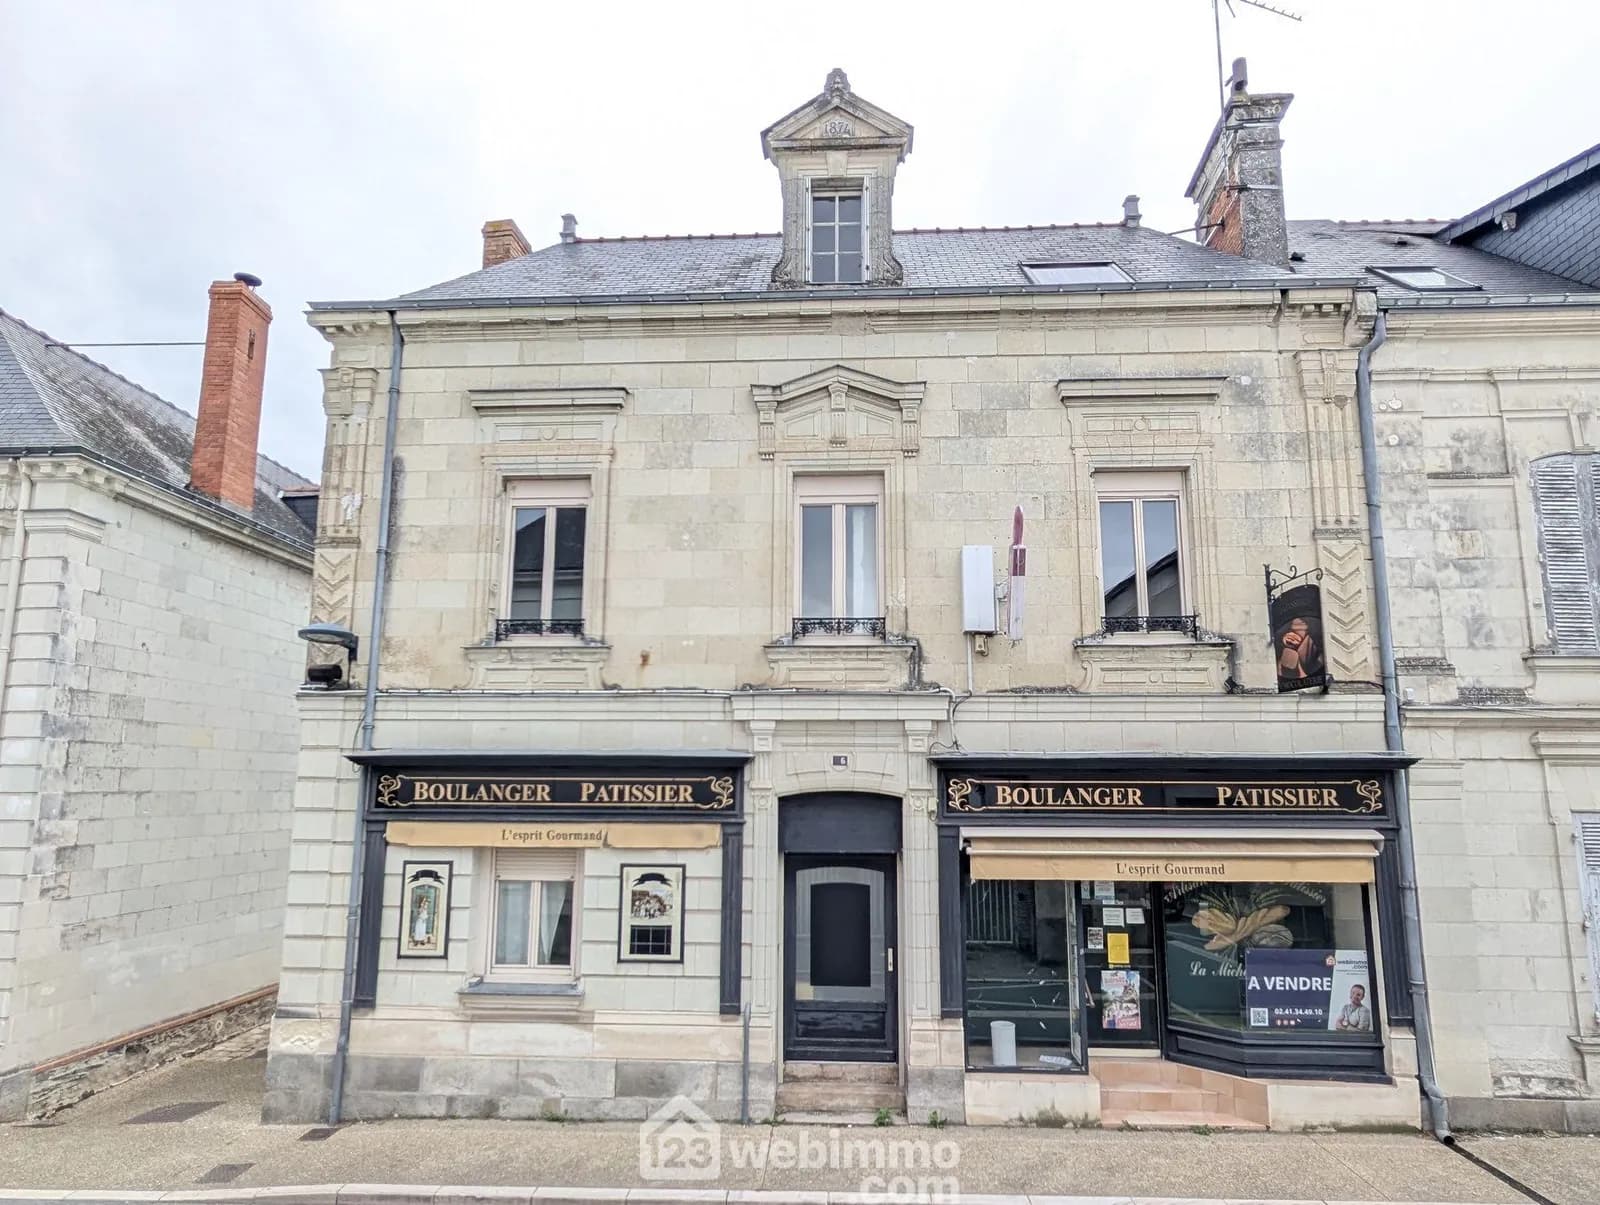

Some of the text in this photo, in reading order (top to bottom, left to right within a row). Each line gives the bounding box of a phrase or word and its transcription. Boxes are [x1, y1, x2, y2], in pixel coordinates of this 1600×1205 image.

[413, 781, 694, 804] BOULANGER PATISSIER
[996, 785, 1339, 807] BOULANGER PATISSIER
[502, 828, 603, 843] L'esprit Gourmand
[1116, 862, 1226, 877] L'esprit Gourmand
[1190, 960, 1207, 976] La
[1247, 976, 1332, 991] A VENDRE
